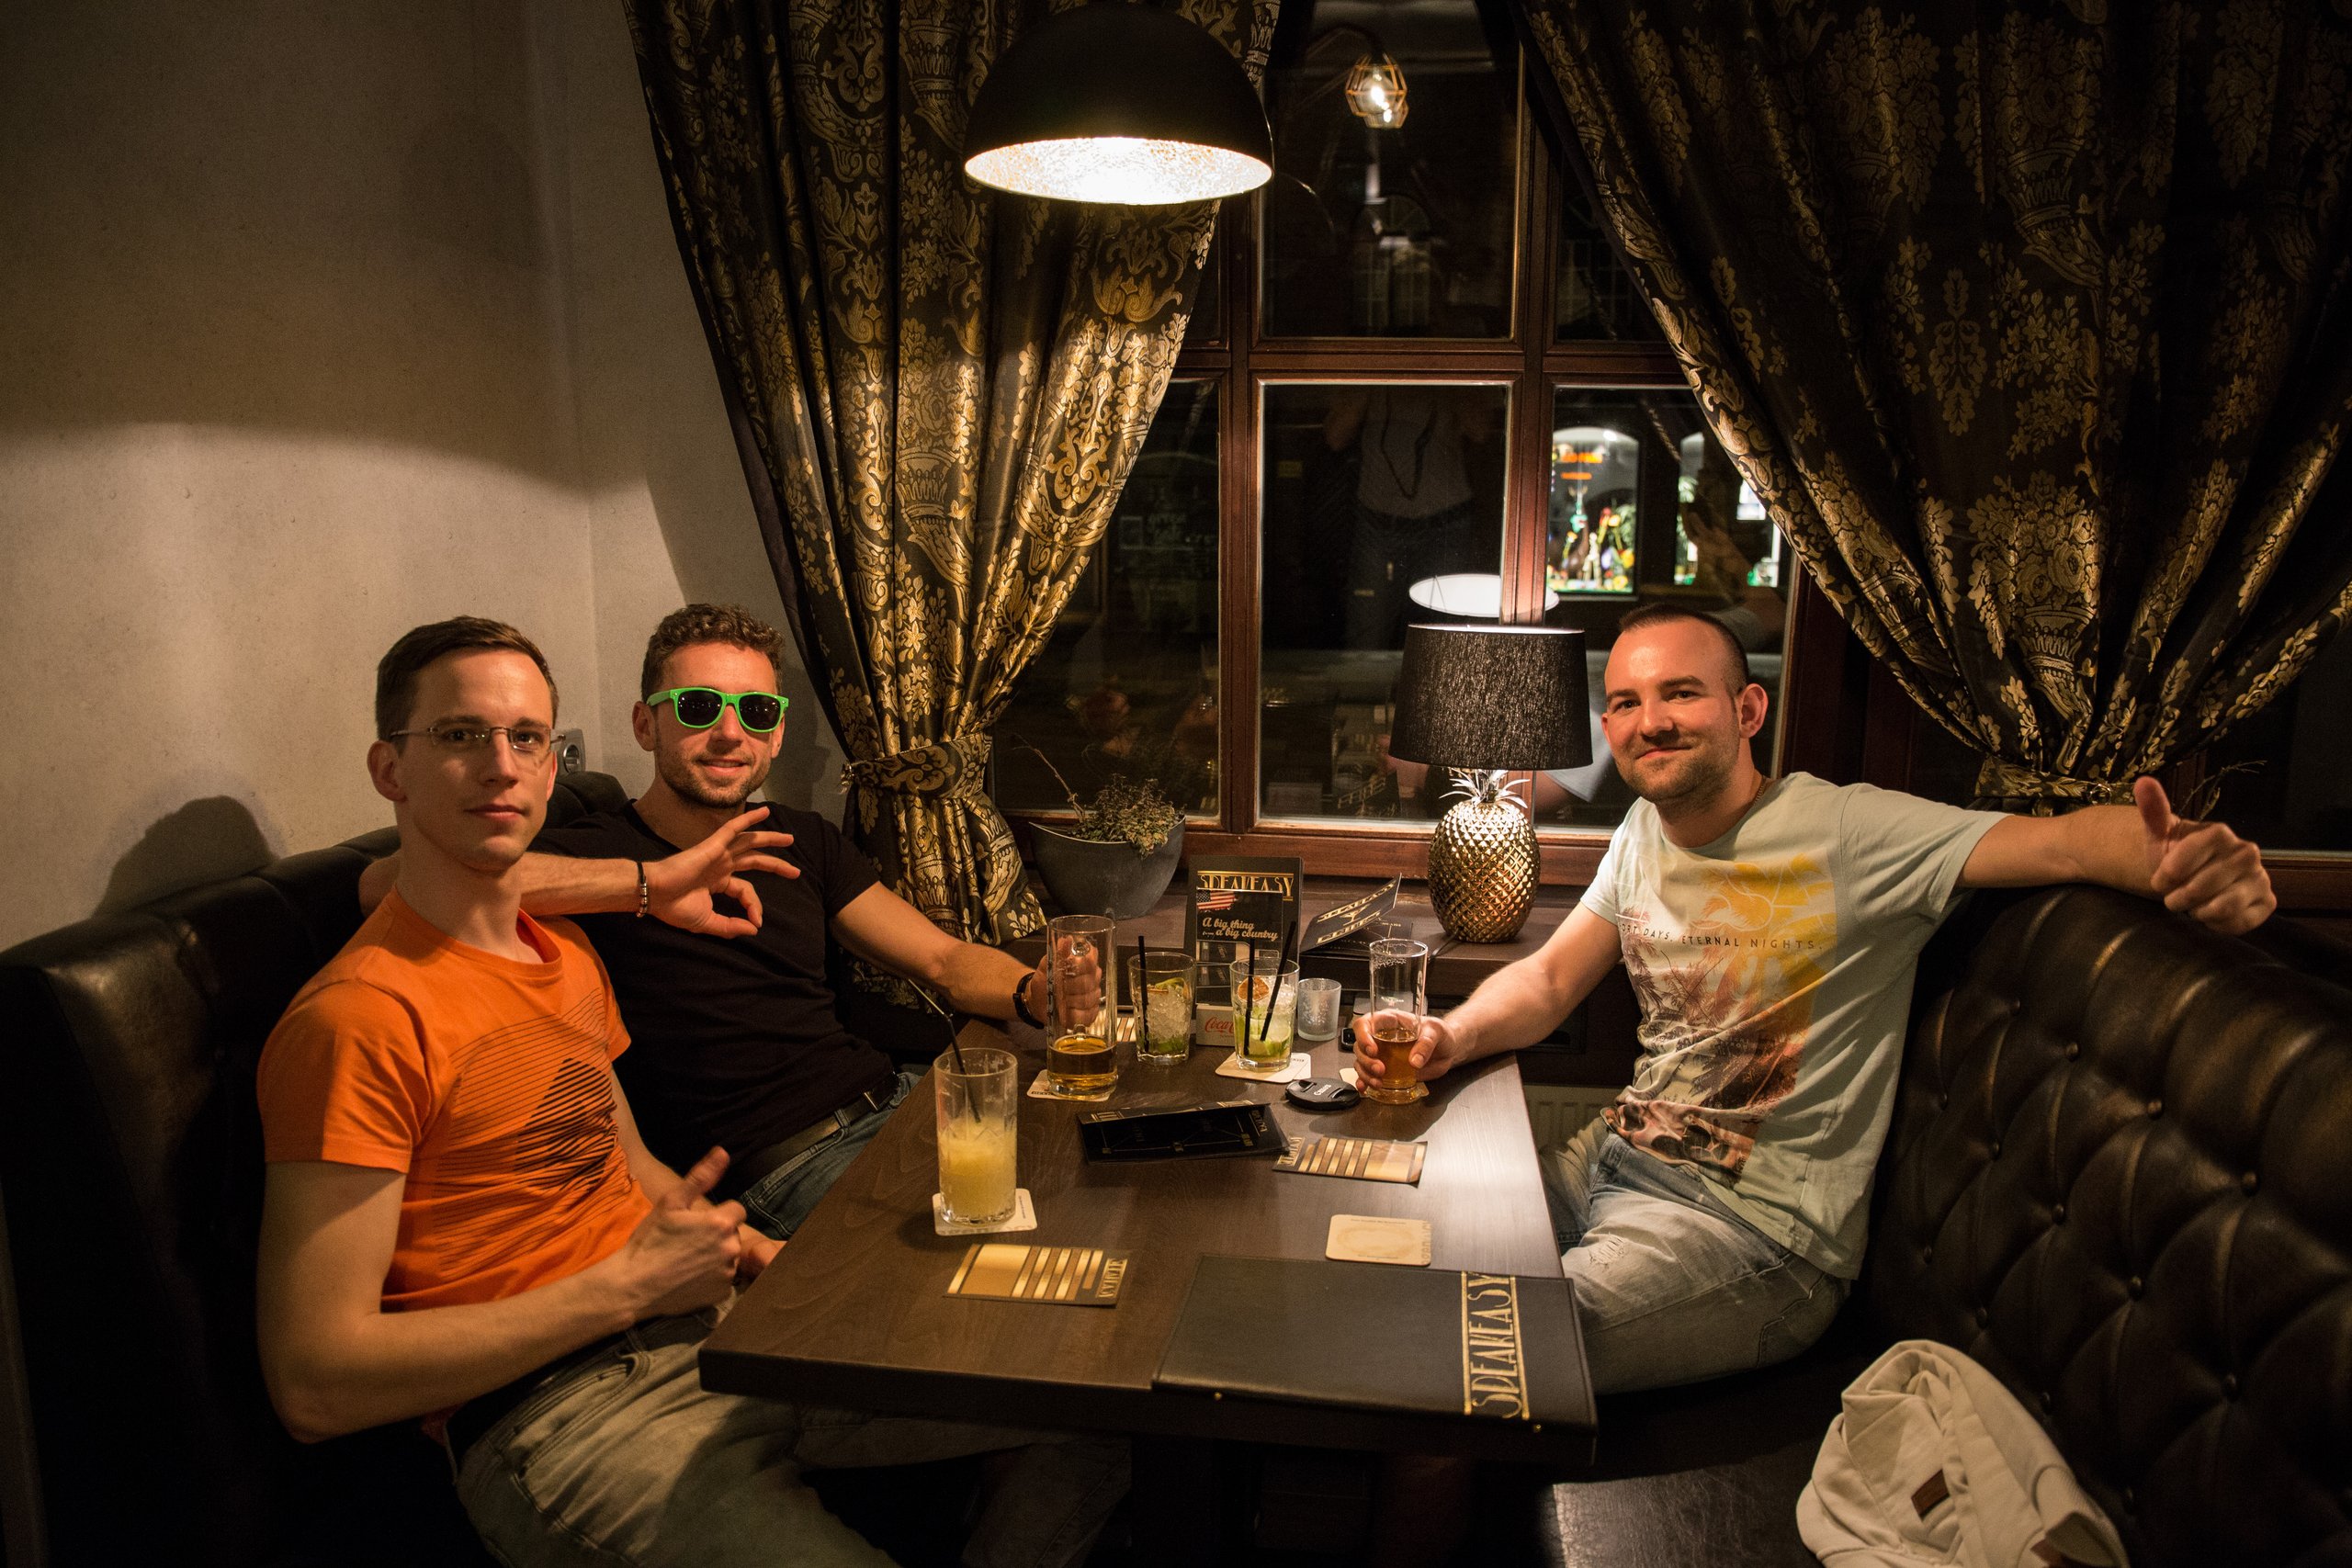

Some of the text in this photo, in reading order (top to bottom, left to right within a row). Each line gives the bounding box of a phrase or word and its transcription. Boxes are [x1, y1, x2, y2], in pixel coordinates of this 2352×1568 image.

[1200, 874, 1294, 897] SPEAKEASY
[1203, 918, 1255, 931] A big thing
[1226, 928, 1240, 940] big
[1242, 930, 1279, 942] country
[1620, 923, 1824, 950] ORT DAYS. ETERNAL NIGHTS.
[1467, 1271, 1523, 1418] SPEAKEASY
